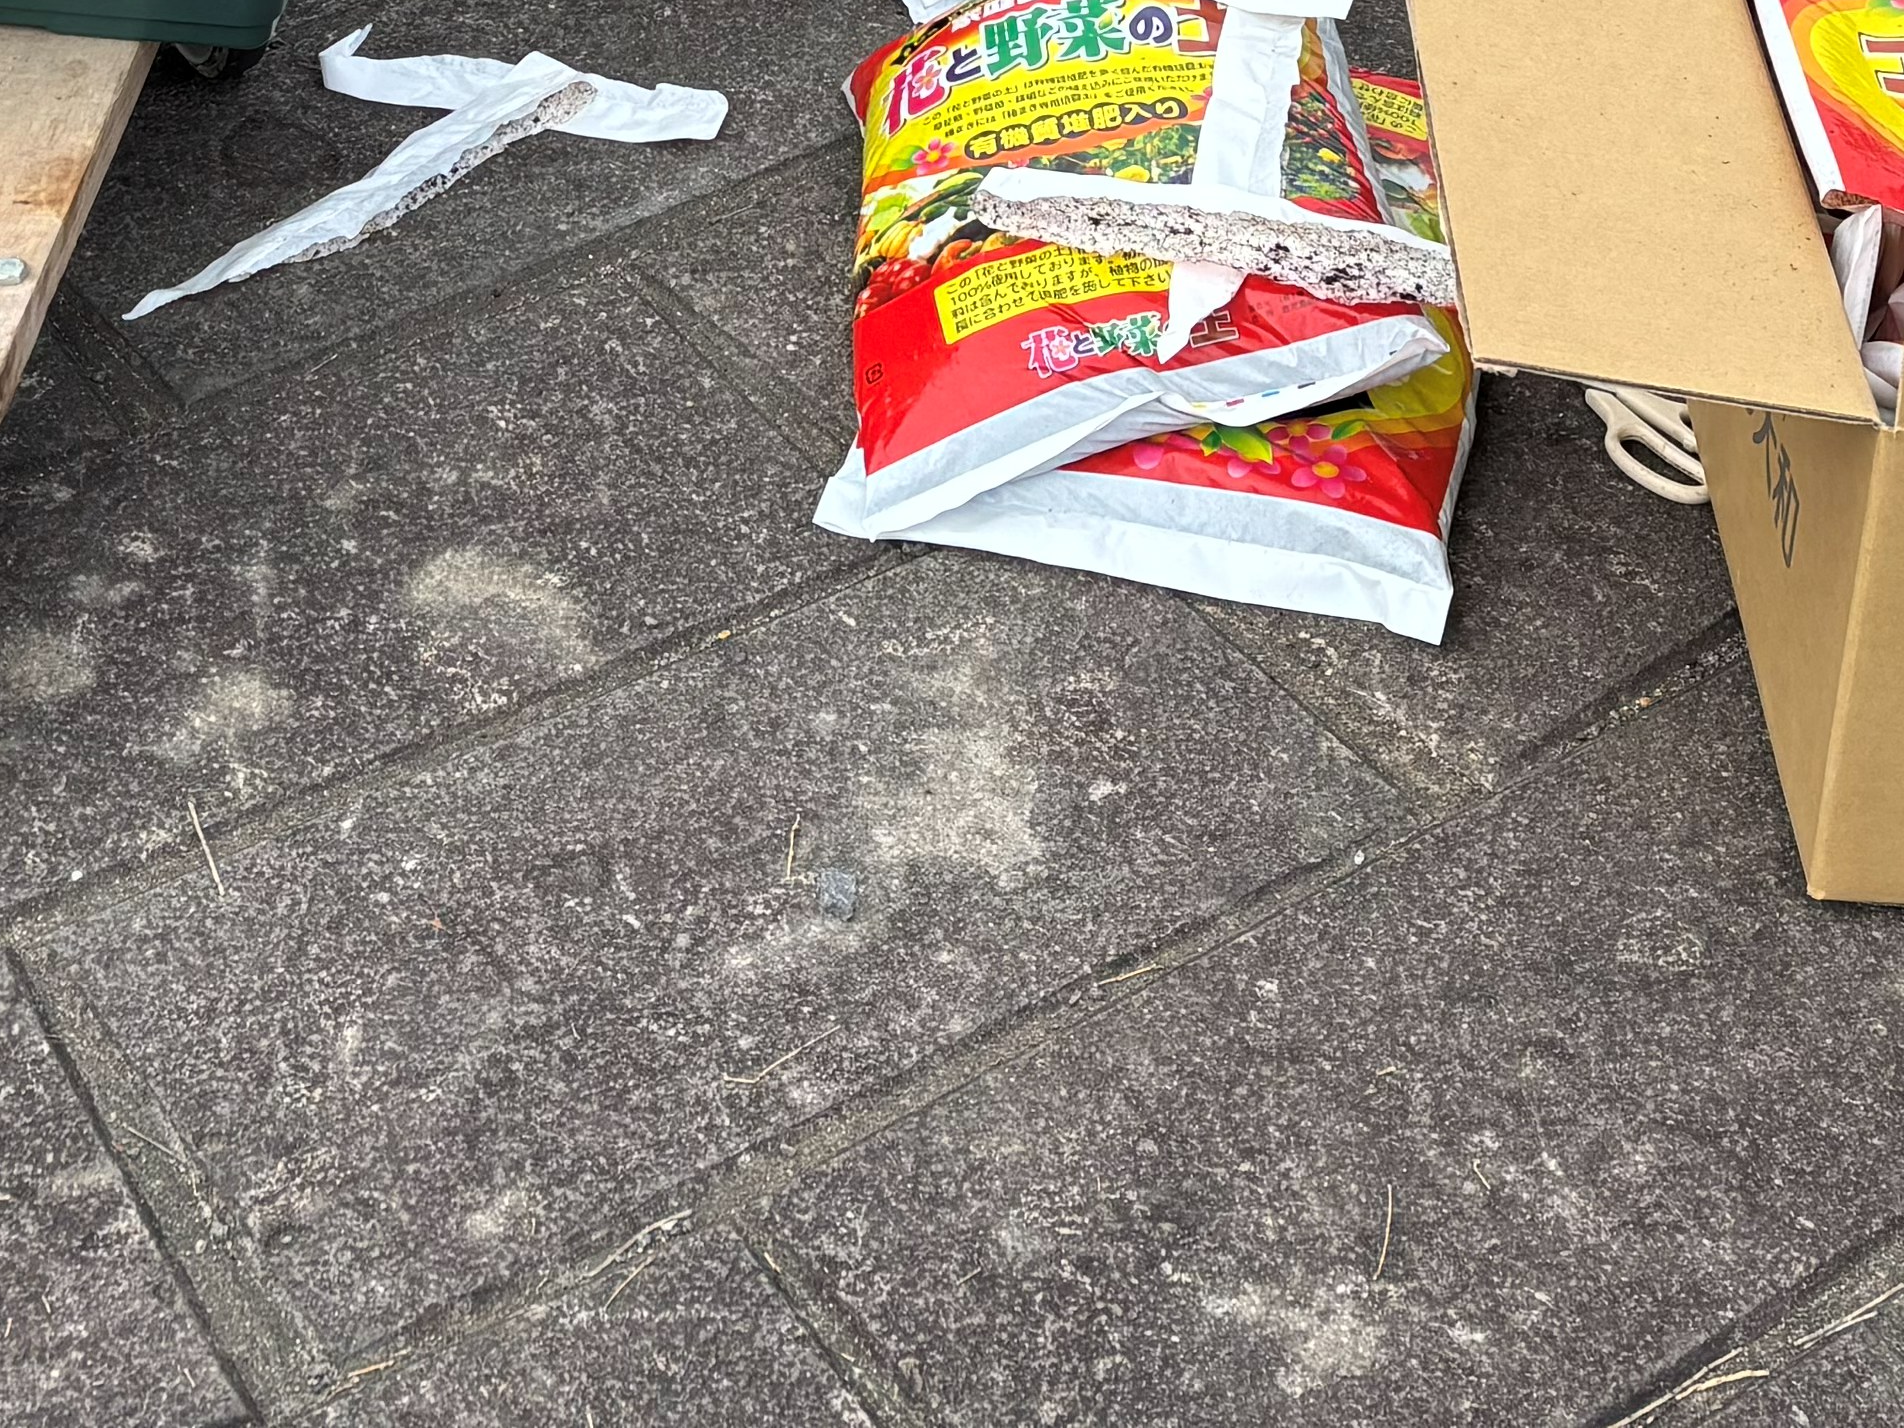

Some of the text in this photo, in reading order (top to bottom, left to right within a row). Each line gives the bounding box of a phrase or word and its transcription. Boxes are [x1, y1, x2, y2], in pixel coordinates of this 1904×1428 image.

[968, 98, 1182, 158] 有機質堆肥入り
[1020, 309, 1240, 379] 花と野菜土
